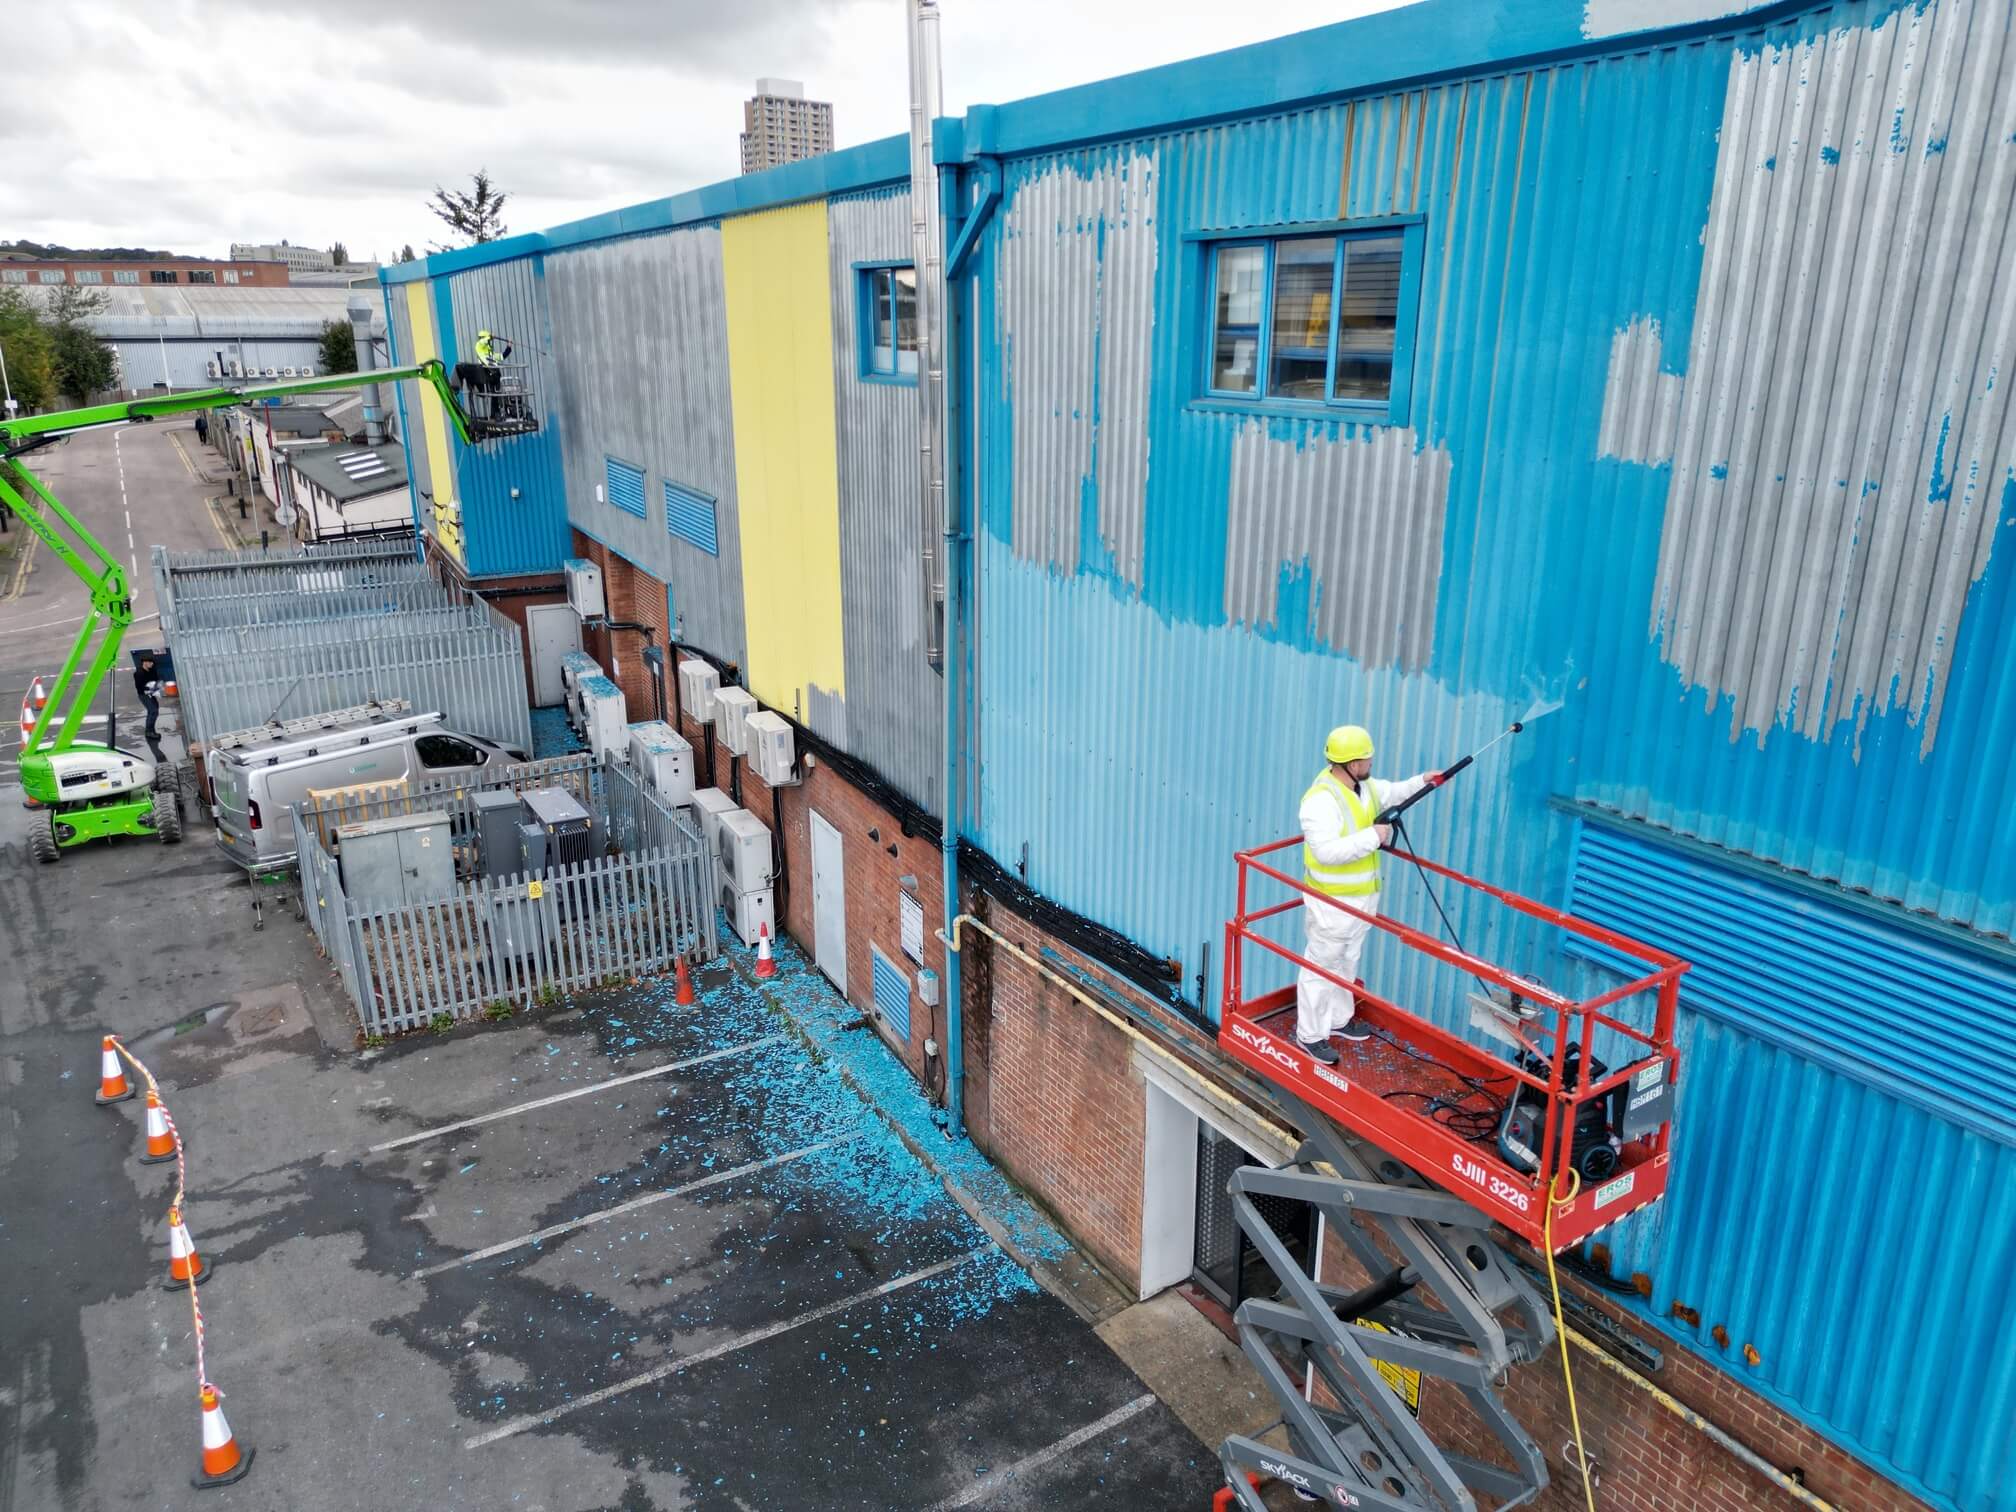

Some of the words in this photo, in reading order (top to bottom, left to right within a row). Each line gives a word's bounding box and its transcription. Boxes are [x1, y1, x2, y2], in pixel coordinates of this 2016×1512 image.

[1232, 1023, 1300, 1074] SKYJACK
[1452, 1154, 1486, 1187] SJIII
[1489, 1176, 1529, 1211] 3226
[1598, 1175, 1632, 1198] EROS
[1260, 1460, 1310, 1488] SKYJACK
